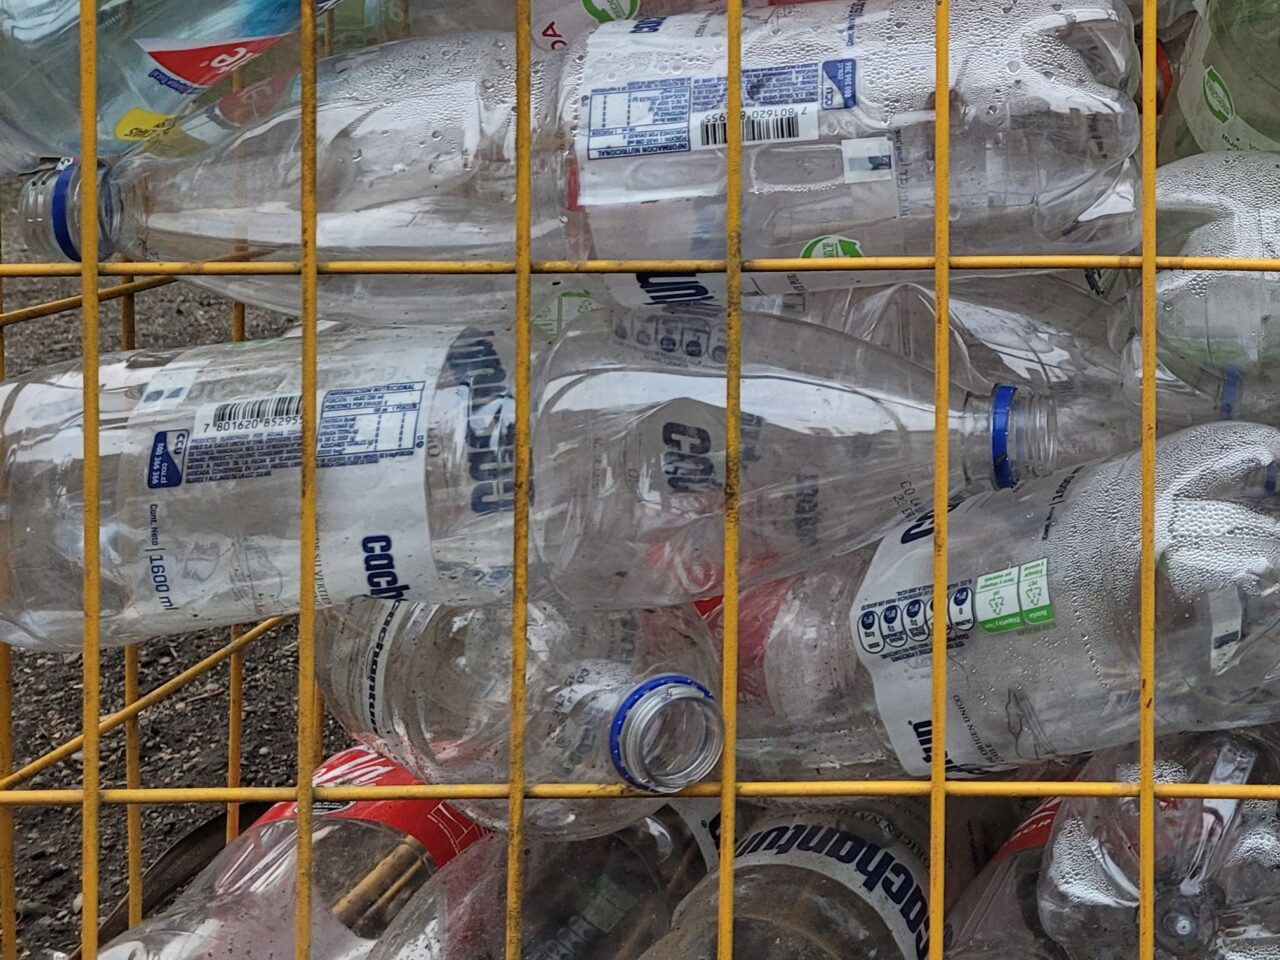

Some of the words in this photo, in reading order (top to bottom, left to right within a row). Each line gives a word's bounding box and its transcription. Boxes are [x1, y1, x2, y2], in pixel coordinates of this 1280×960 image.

[824, 87, 835, 107] CCU
[752, 108, 795, 118] 801620
[597, 145, 642, 157] NUTRICIONAL
[642, 142, 688, 154] INFORMACION
[203, 423, 209, 433] 7
[215, 419, 258, 432] 801620
[173, 433, 187, 455] CCU
[148, 553, 171, 594] 1600
[159, 595, 176, 611] ml
